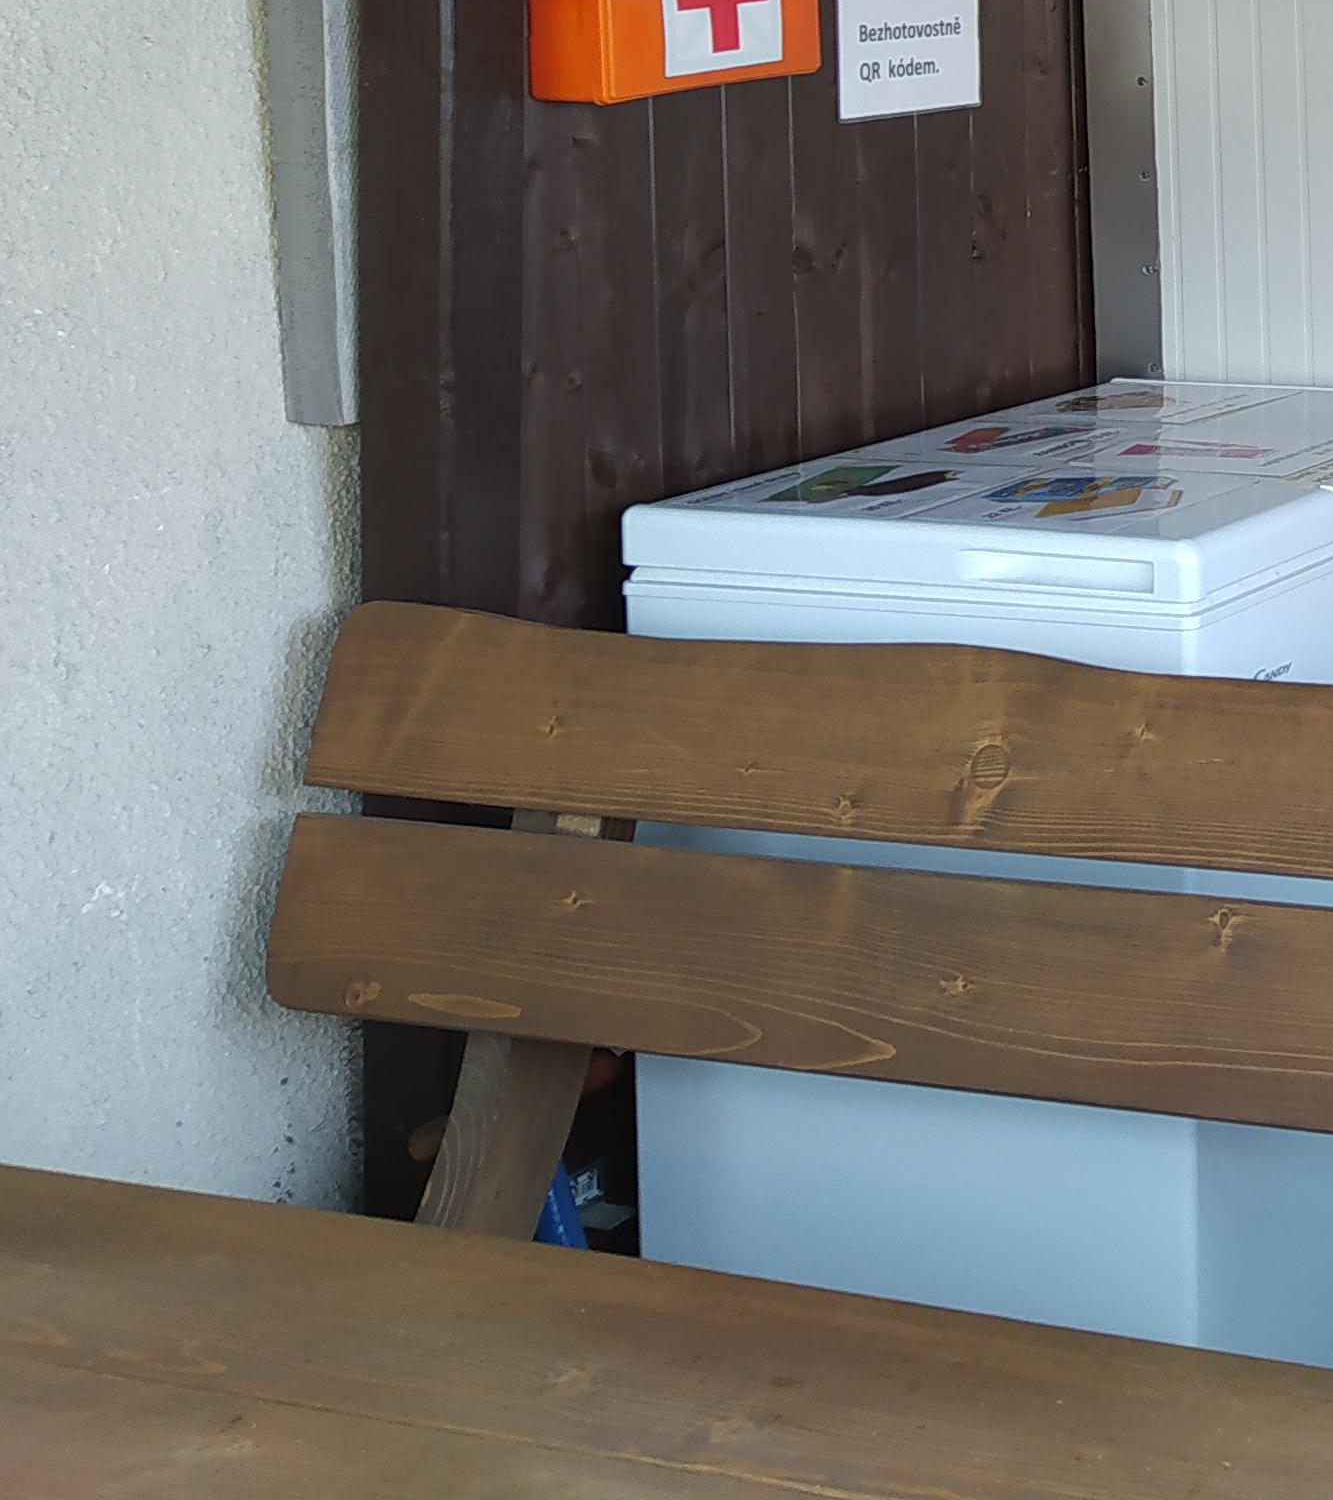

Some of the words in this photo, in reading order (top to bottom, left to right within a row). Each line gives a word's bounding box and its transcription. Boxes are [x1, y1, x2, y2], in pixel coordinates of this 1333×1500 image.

[859, 17, 961, 43] Bezhotovostně
[860, 61, 881, 83] QR
[888, 57, 940, 78] kódem.
